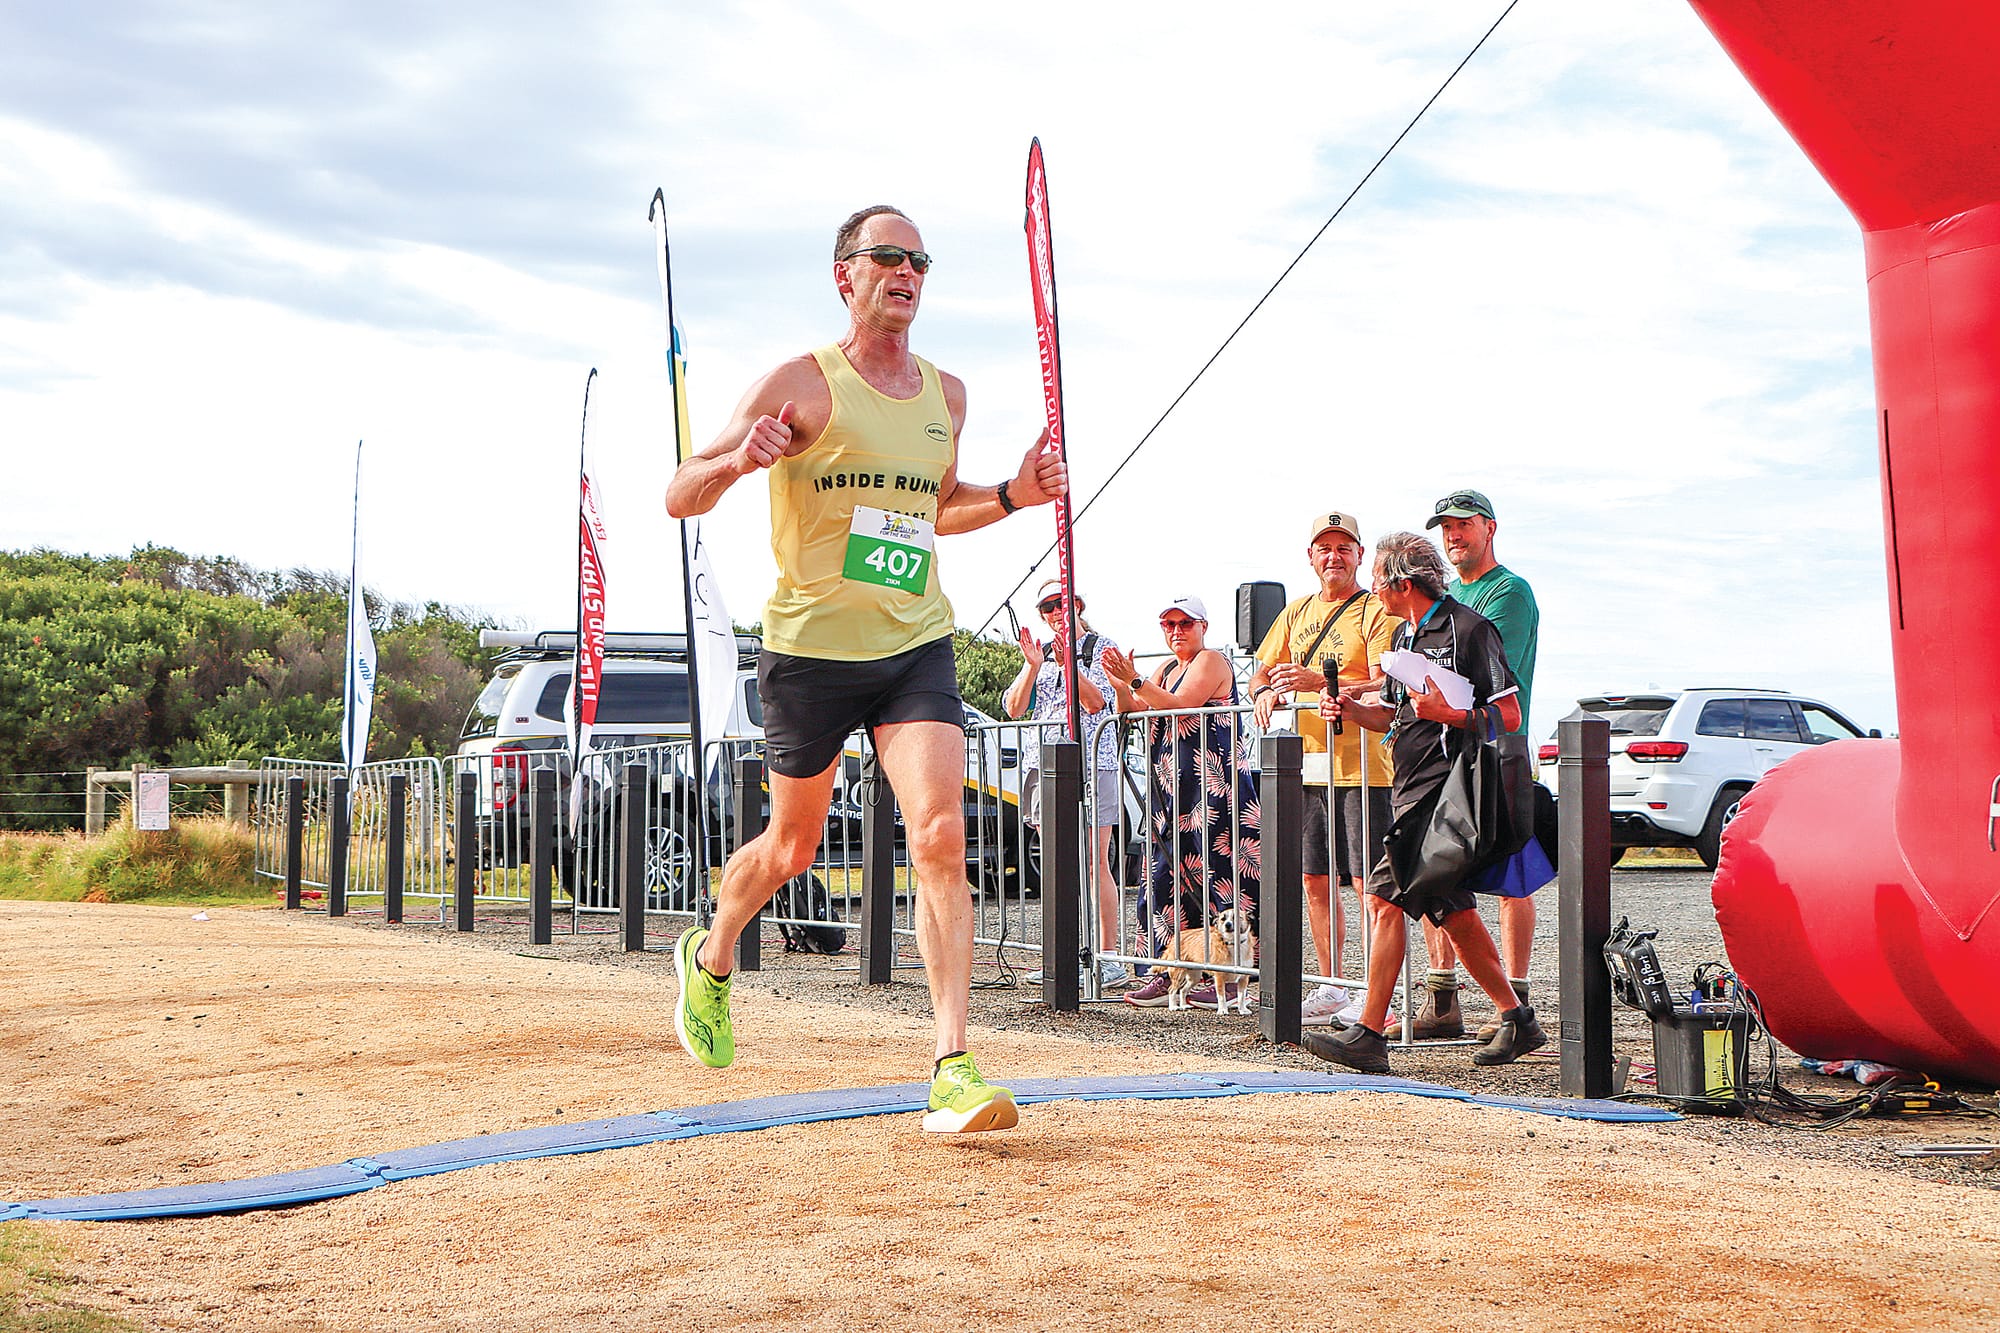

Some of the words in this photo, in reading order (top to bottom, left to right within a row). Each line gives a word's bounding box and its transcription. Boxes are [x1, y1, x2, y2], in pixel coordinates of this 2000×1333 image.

[813, 473, 885, 493] INSIDE
[864, 545, 923, 580] 407
[588, 617, 605, 658] AND
[1294, 621, 1345, 650] TRADEARK
[358, 658, 374, 681] RUN
